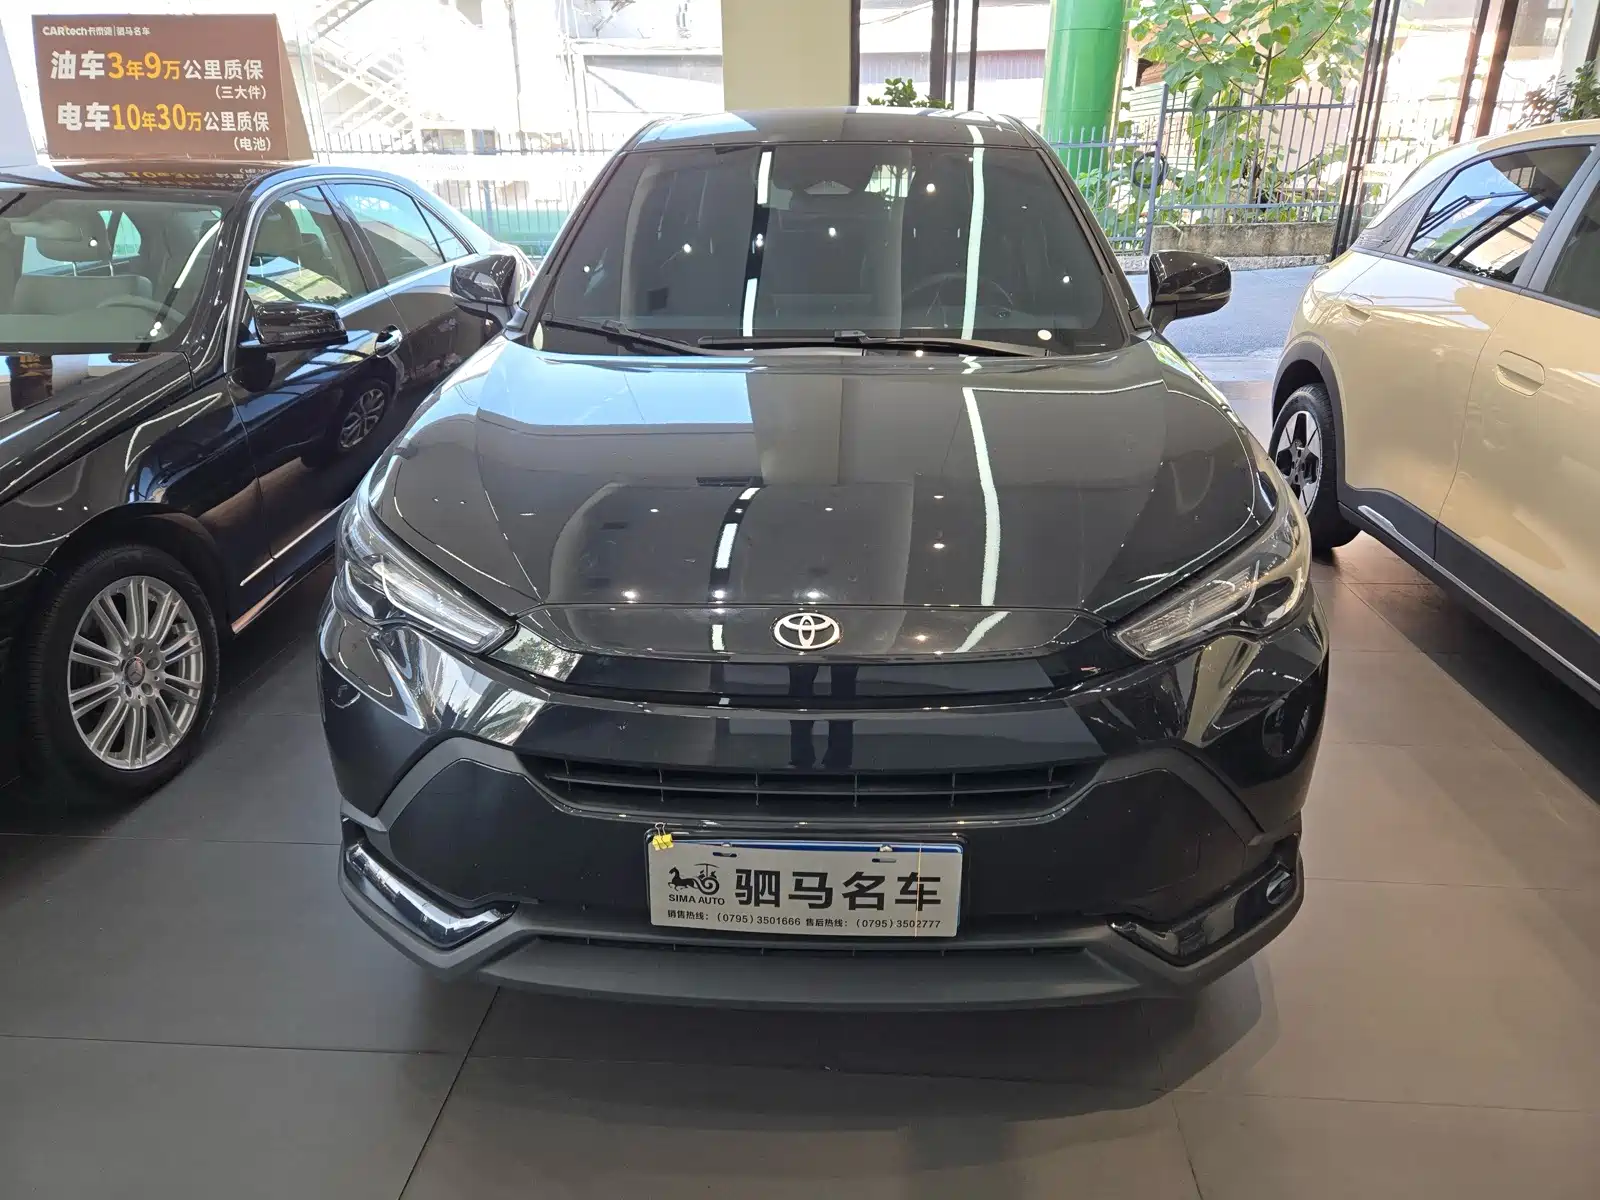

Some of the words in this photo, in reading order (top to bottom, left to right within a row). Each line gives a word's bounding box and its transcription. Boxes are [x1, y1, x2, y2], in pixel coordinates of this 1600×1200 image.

[668, 893, 696, 904] SIMA
[698, 896, 725, 906] AUTO
[735, 868, 942, 912] 驷马名车
